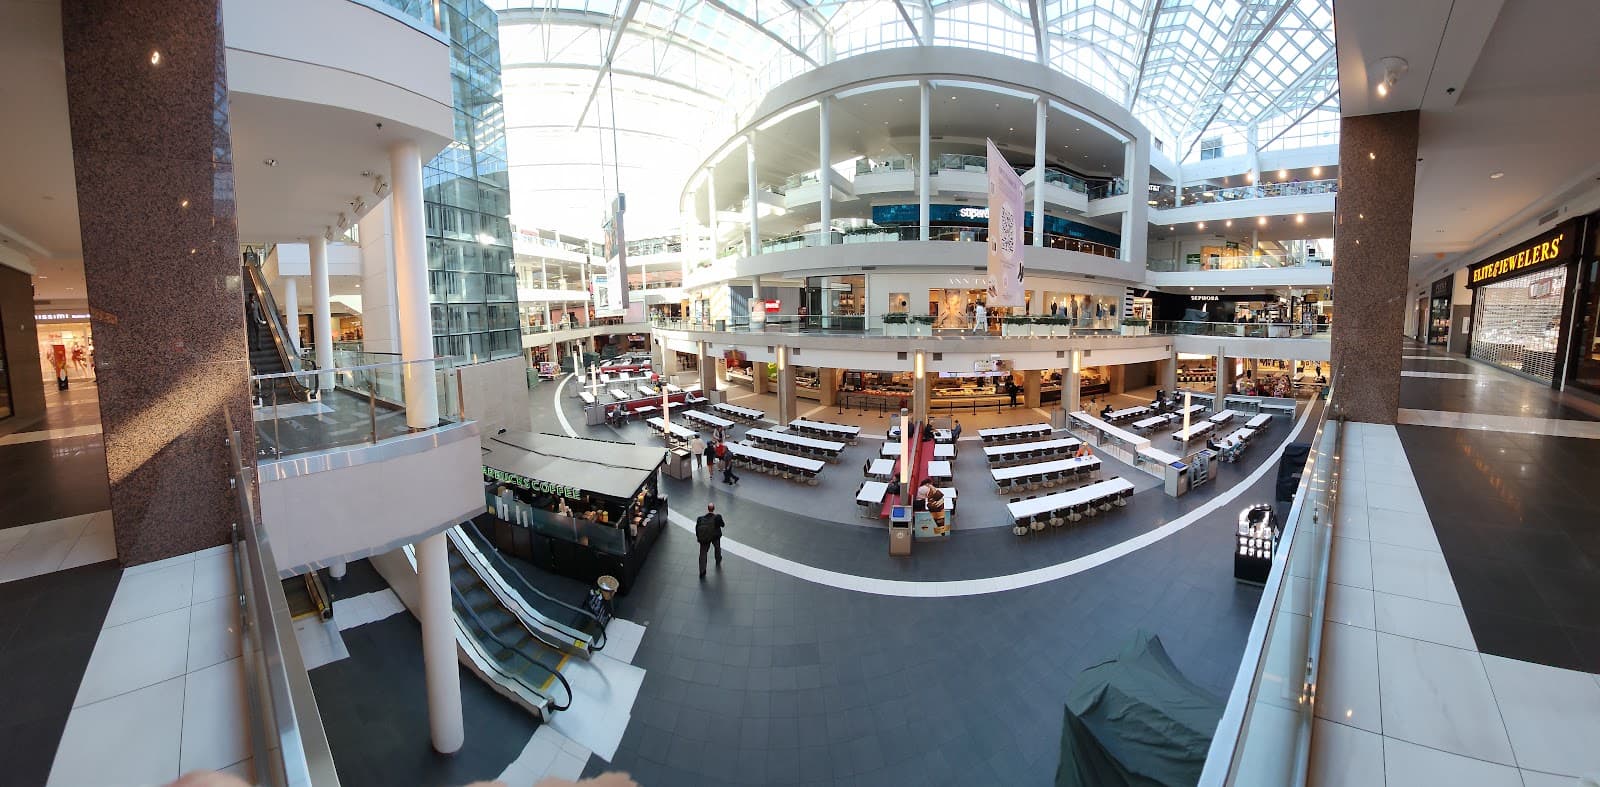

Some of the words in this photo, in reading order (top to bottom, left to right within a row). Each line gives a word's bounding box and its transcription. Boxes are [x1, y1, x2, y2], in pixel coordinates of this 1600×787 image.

[1148, 184, 1160, 192] T&T
[960, 207, 989, 219] superd
[1473, 263, 1494, 282] ELITE
[481, 465, 531, 489] ARBUCKS
[531, 479, 582, 500] COFFEE
